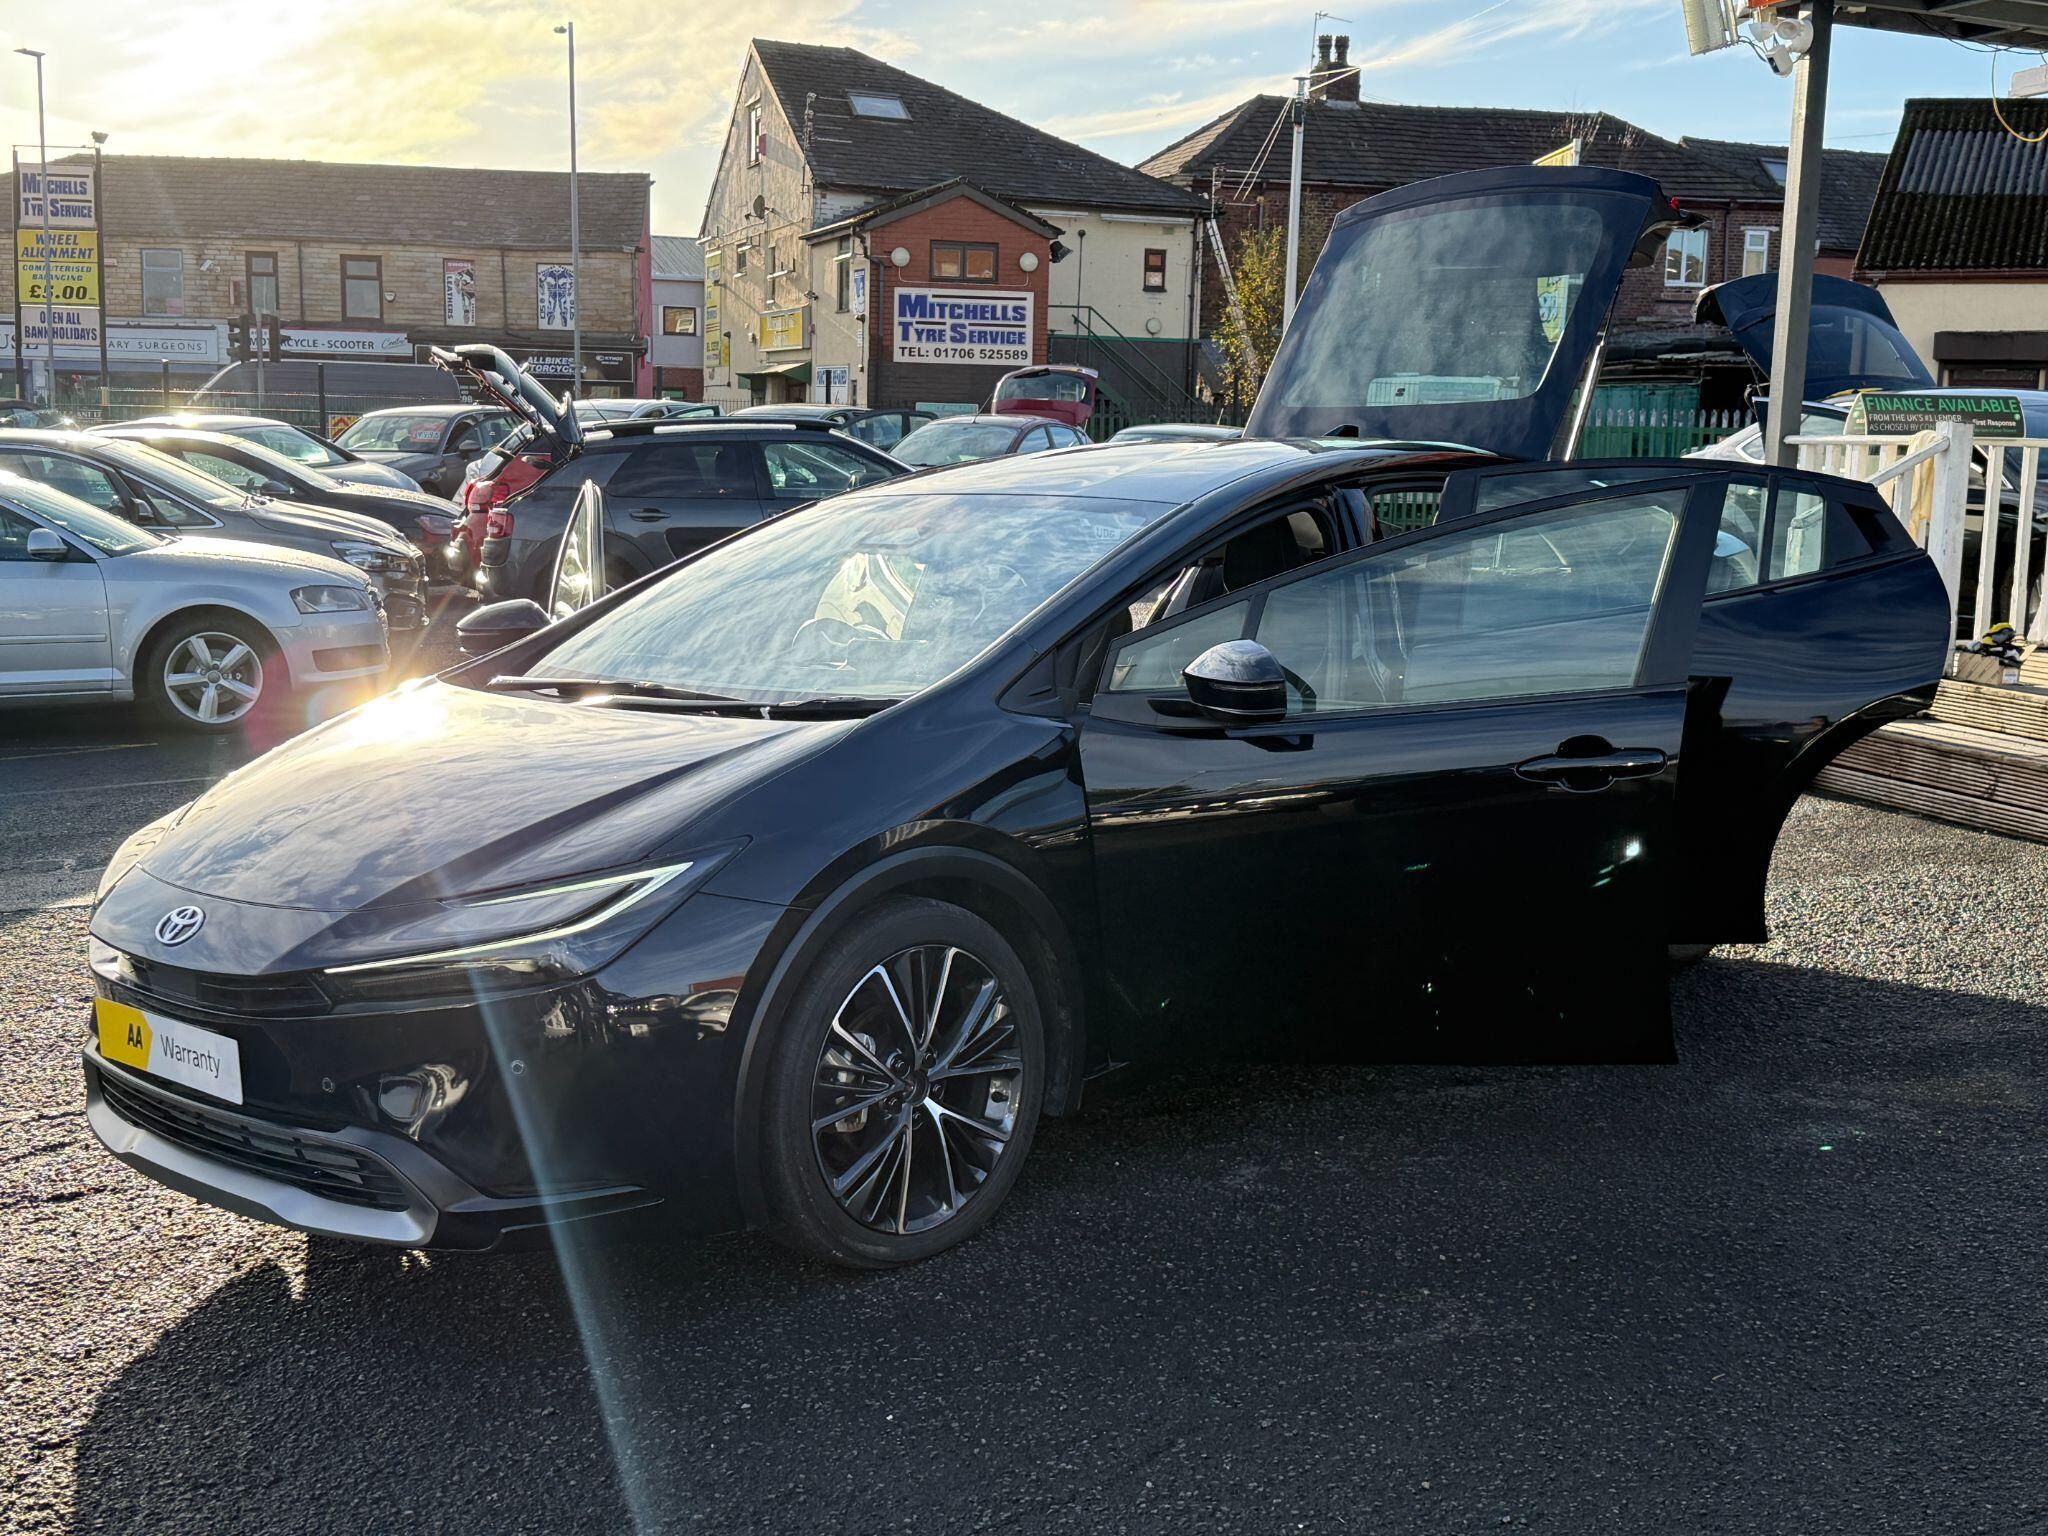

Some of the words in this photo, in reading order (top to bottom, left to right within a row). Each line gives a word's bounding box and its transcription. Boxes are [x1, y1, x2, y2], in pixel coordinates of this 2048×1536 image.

[22, 173, 88, 195] MICHELLS
[22, 197, 48, 216] TYR
[50, 198, 93, 218] SERVICE
[446, 276, 454, 320] LEATHERS
[898, 293, 1026, 322] MITCHELLS
[40, 310, 63, 324] OEN
[65, 312, 81, 325] ALL
[52, 327, 97, 341] HOLIDAYS
[898, 321, 947, 343] TYRE
[950, 323, 1026, 345] SERVICE
[138, 341, 202, 351] SURGEONS
[327, 339, 374, 350] SCOOTER
[899, 346, 930, 358] TEL:
[934, 347, 975, 359] 01706
[979, 349, 1028, 360] 525589
[527, 356, 575, 366] ALLBIKES
[1866, 396, 1935, 411] FINANCE
[1938, 398, 2020, 413] AVAILABLE
[1869, 413, 1890, 421] FROM
[1891, 413, 1906, 421] THE
[1869, 423, 1878, 431] AS
[1880, 423, 1909, 431] CHOSEN
[1910, 423, 1919, 431] BY
[127, 1022, 143, 1049] AA
[160, 1033, 221, 1078] Warranty
